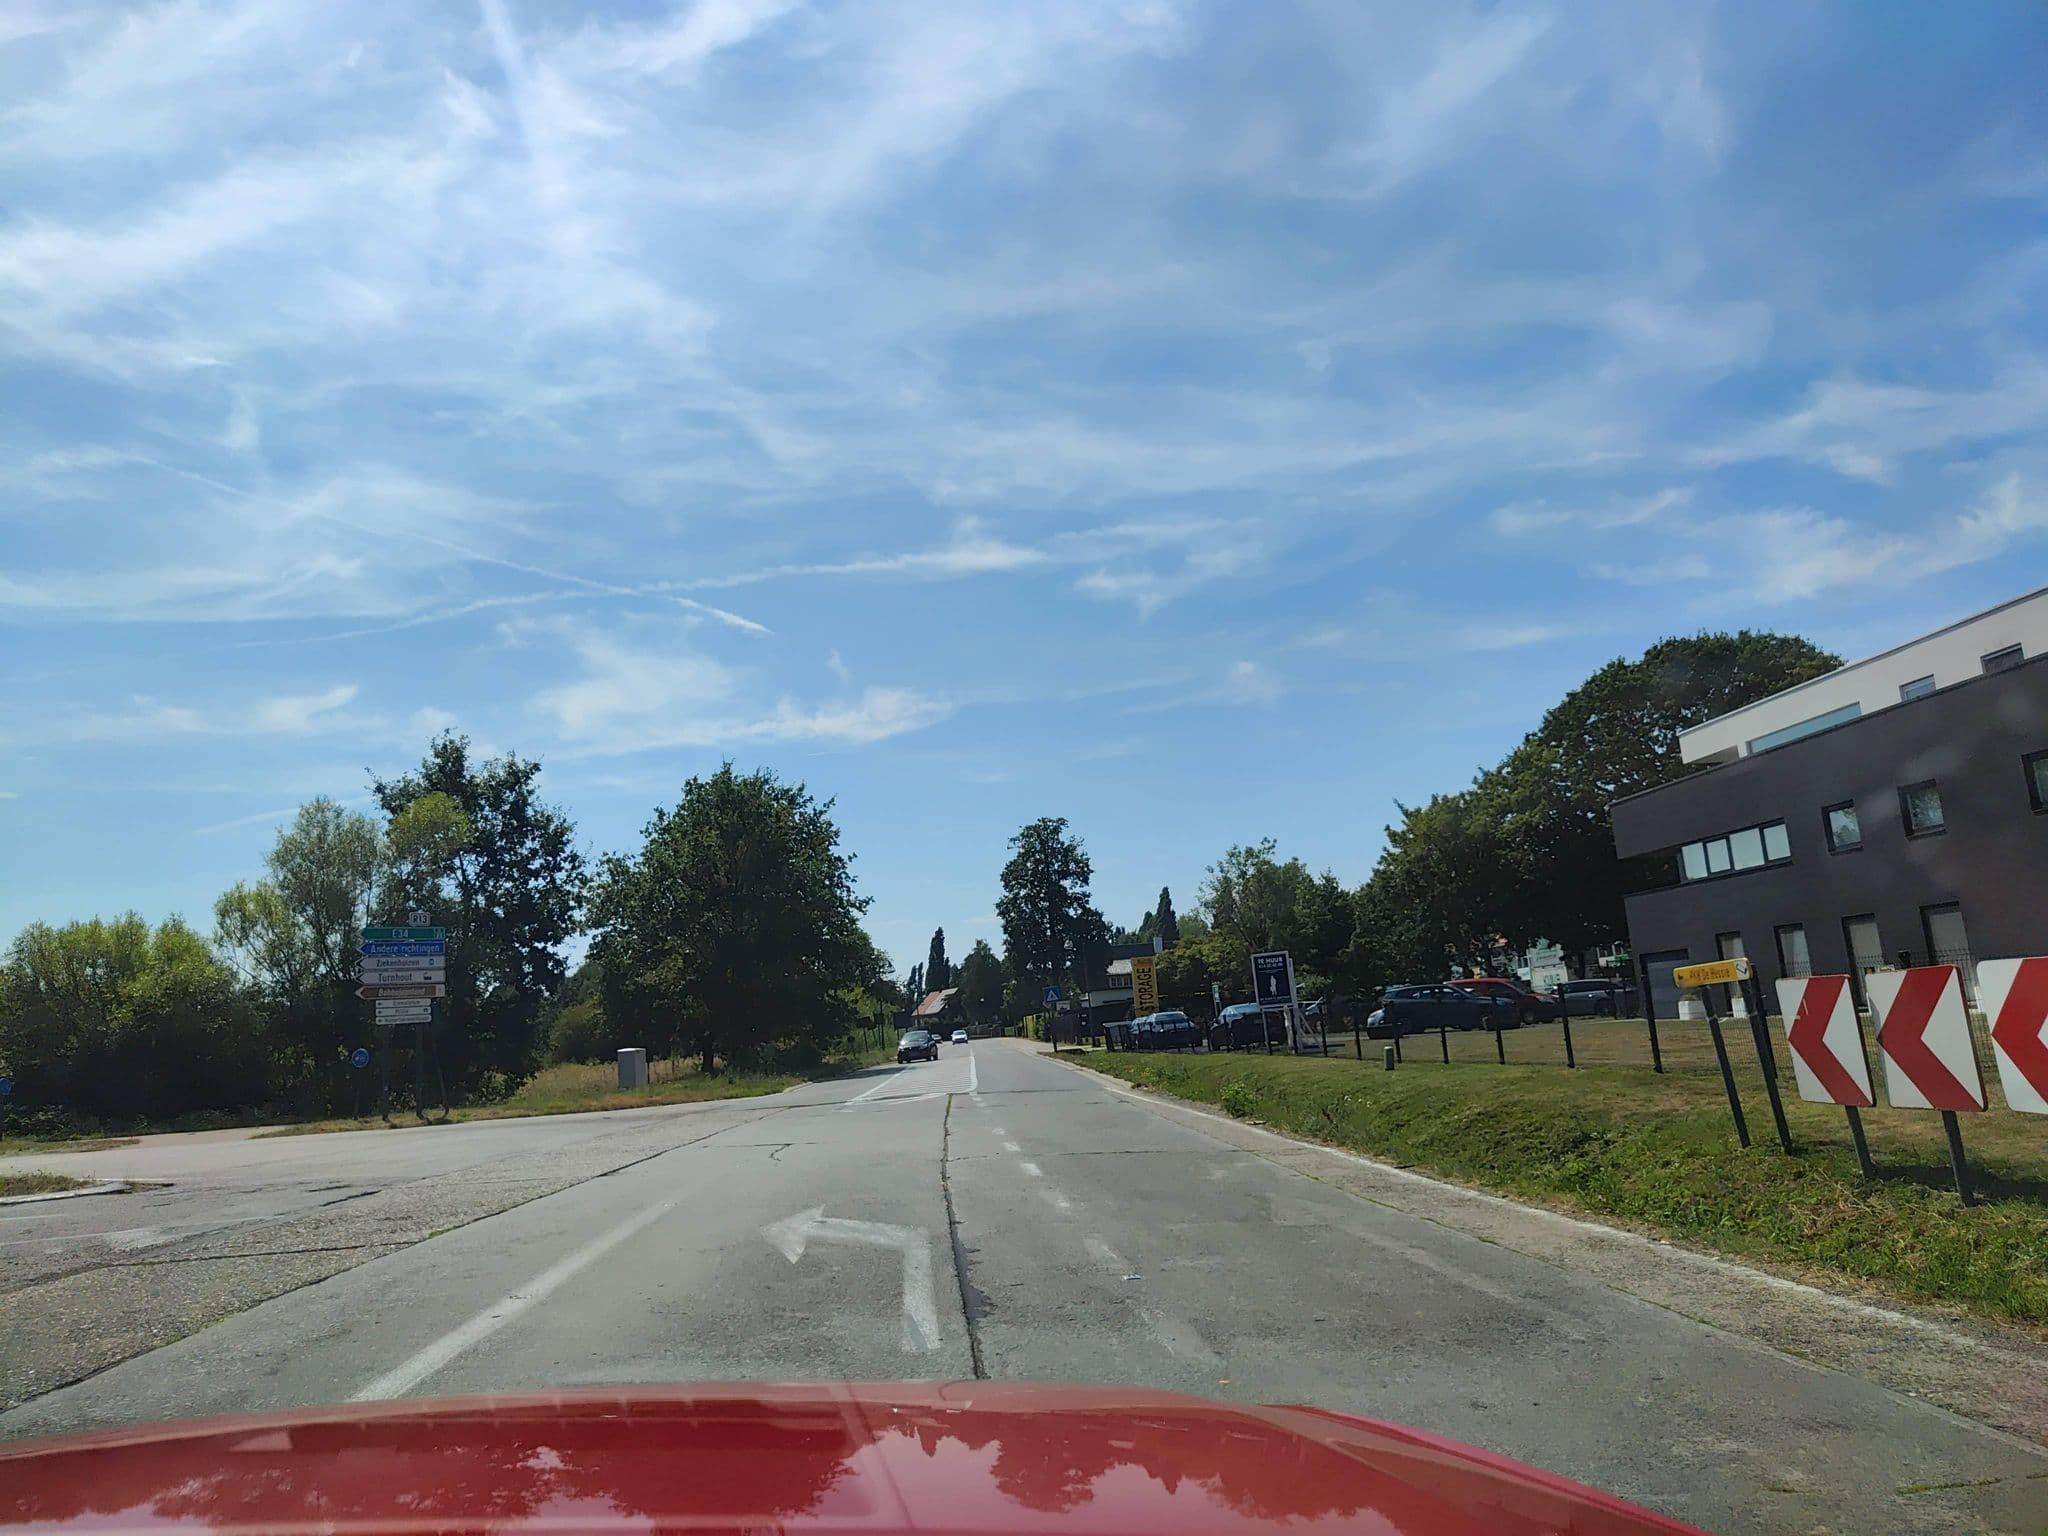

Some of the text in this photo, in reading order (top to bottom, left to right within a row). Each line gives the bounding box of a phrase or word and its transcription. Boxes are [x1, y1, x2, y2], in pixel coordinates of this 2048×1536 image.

[412, 914, 427, 924] R13
[392, 929, 409, 938] E34
[370, 943, 440, 955] Andere richtingen
[376, 959, 420, 967] Ziekenhuizen
[377, 972, 413, 982] Turnhout
[1136, 967, 1155, 1012] STORAGE
